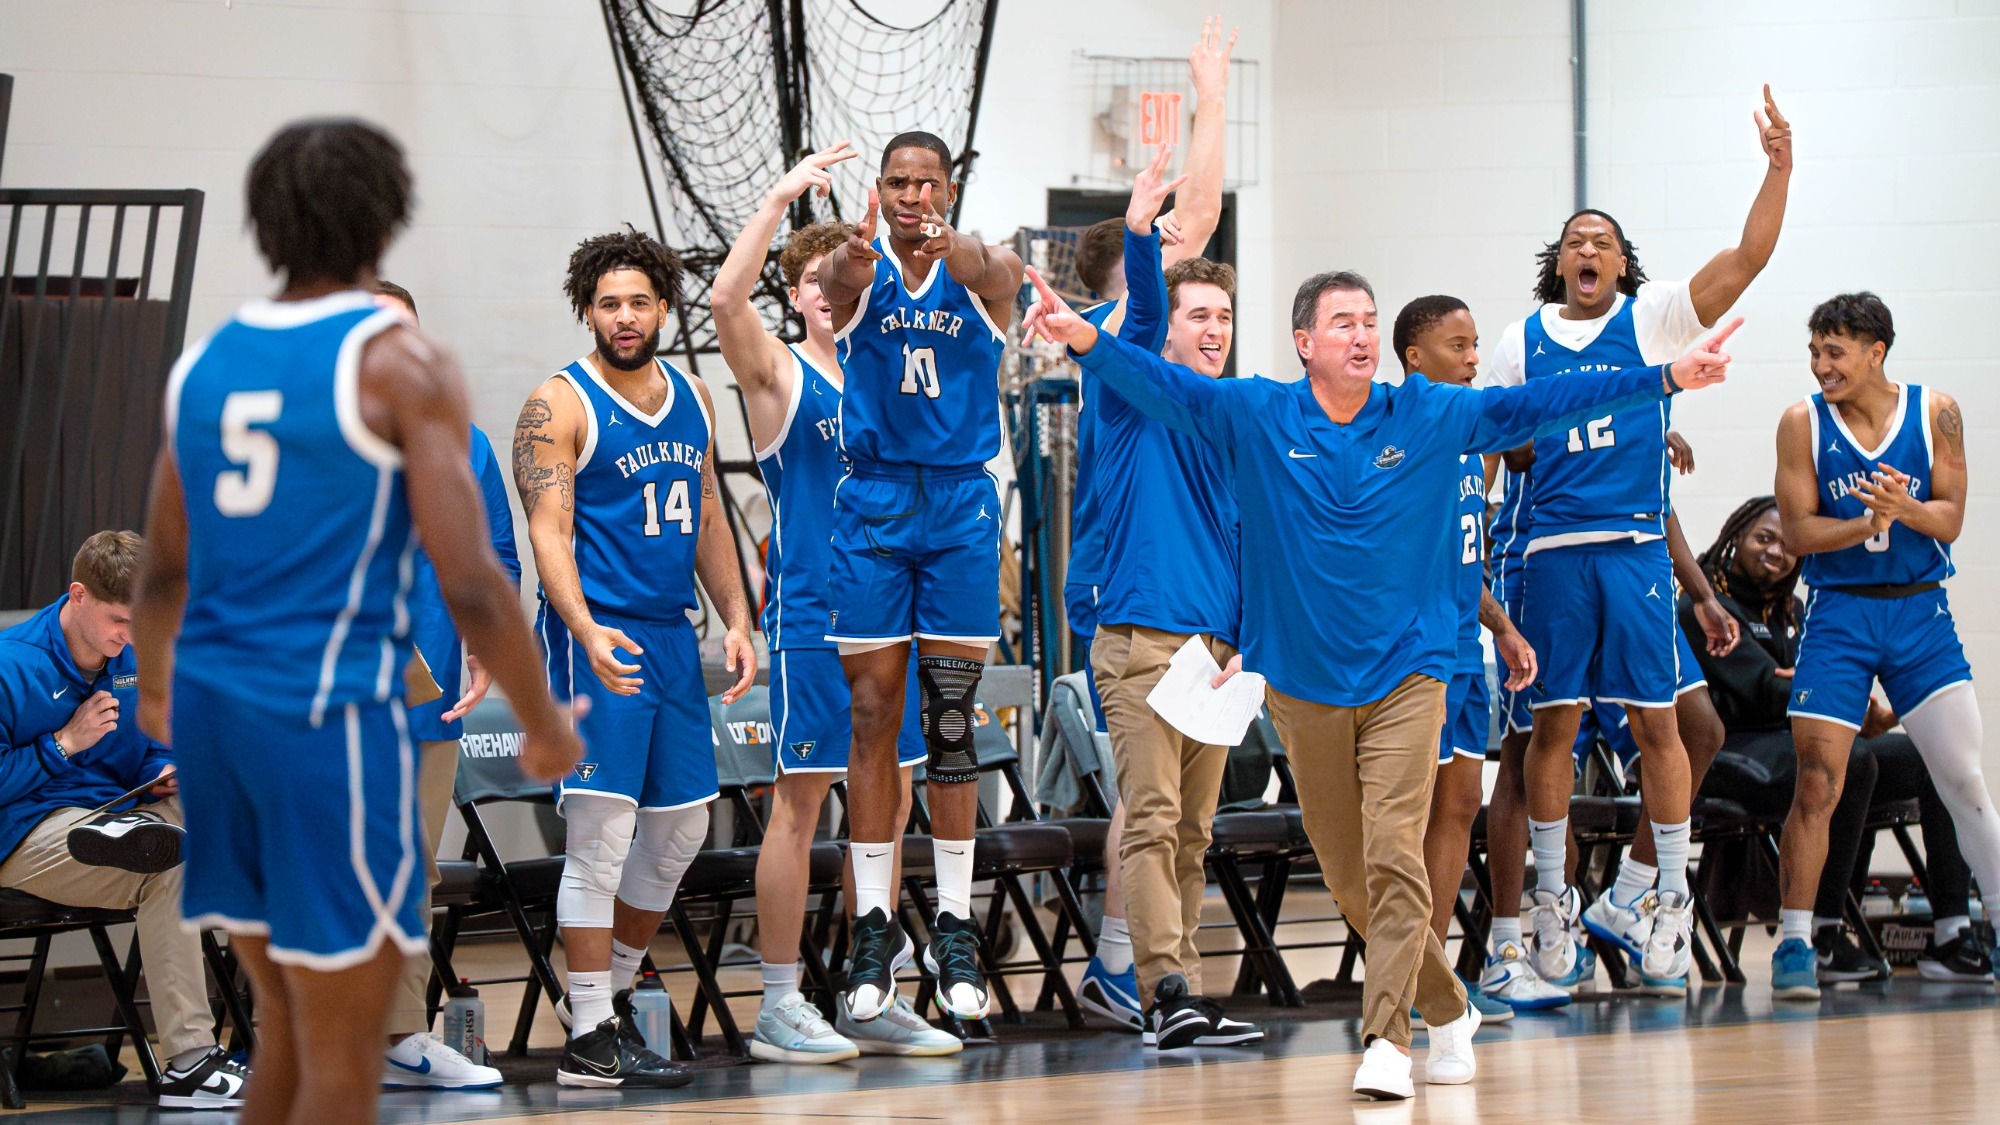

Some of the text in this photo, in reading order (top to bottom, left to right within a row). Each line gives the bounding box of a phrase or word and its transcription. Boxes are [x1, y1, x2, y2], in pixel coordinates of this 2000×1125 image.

[1141, 92, 1181, 145] EXIT
[880, 306, 964, 338] FALKNER
[900, 342, 941, 398] 10
[213, 389, 284, 518] 5
[614, 441, 704, 479] FAULKNER
[643, 480, 693, 536] 14
[1461, 511, 1485, 565] 21
[459, 732, 527, 758] FIREHAW
